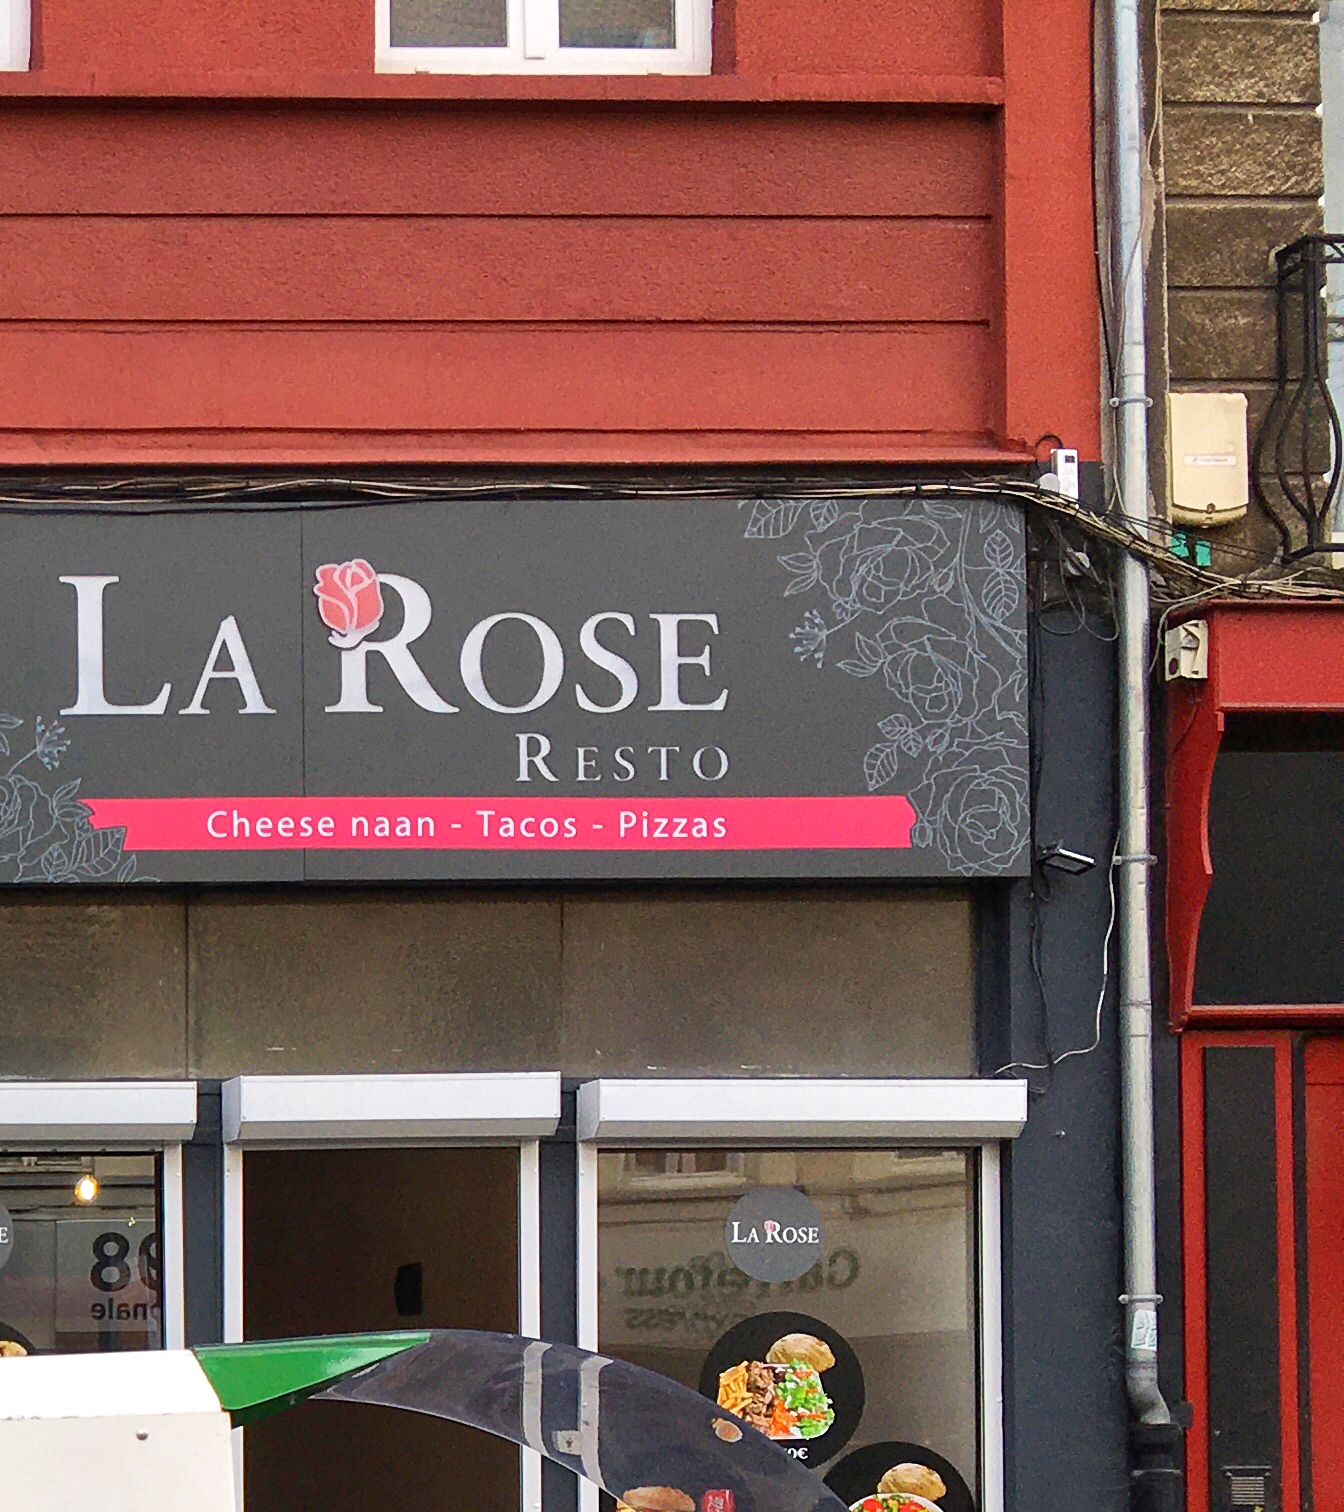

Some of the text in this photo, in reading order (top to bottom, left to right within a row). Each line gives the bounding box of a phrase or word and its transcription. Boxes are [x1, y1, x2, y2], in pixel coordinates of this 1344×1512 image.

[58, 572, 729, 717] LA ROSE
[515, 732, 729, 783] RESTO
[206, 809, 335, 839] Cheese
[350, 815, 436, 839] naan
[475, 811, 578, 838] Tacos
[619, 809, 728, 838] Pizzas
[731, 1221, 820, 1244] LA ROSE
